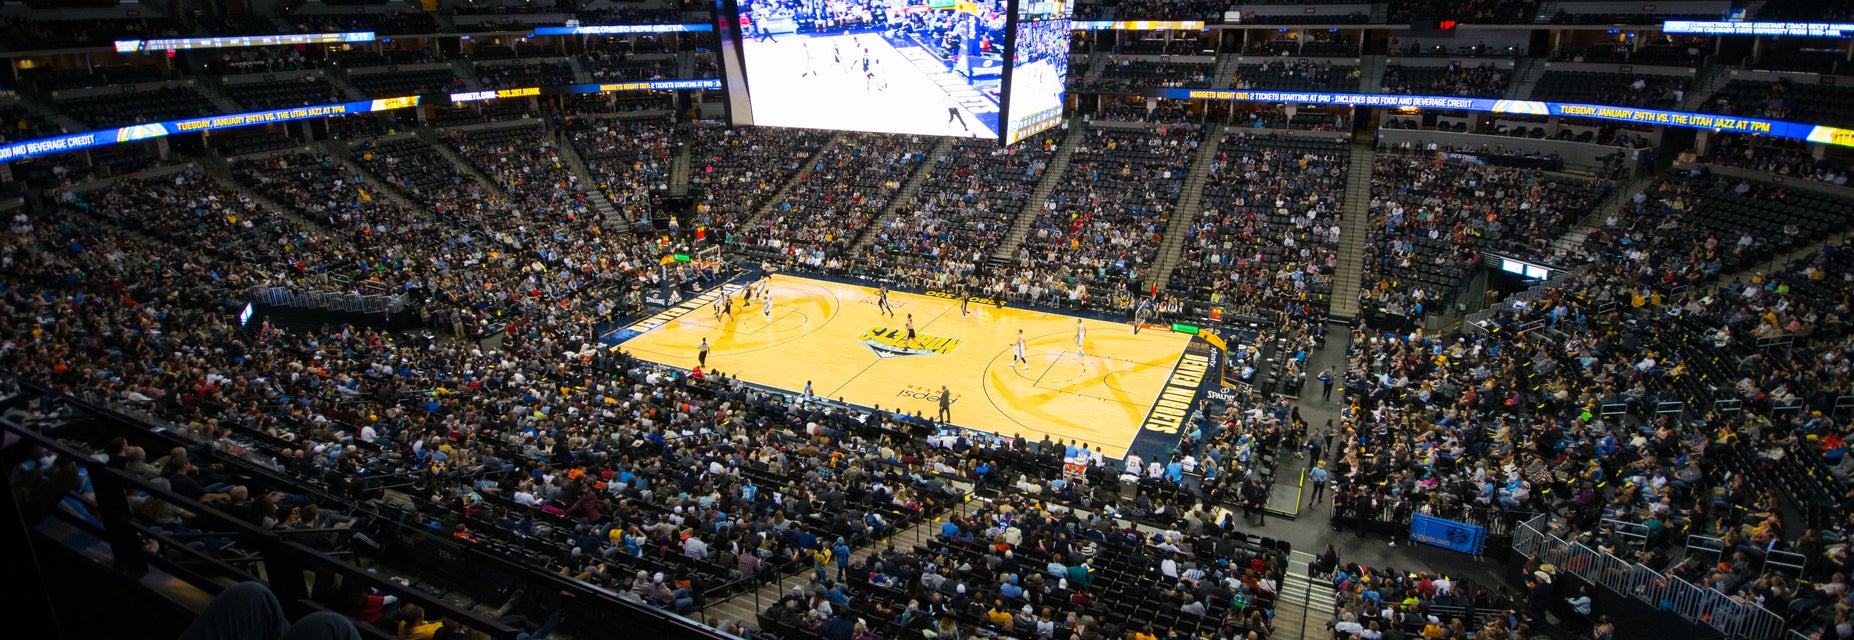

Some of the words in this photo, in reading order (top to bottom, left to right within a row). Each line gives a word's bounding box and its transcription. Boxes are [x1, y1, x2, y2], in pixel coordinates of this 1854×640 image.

[1335, 95, 1365, 103] INCLUDES
[1366, 96, 1379, 104] $30
[1381, 96, 1398, 104] FOOD
[1414, 98, 1446, 106] BEVERAGE
[1447, 99, 1473, 108] CREDIT
[176, 120, 213, 131] TUESDAY,
[214, 117, 245, 128] JANUARY
[246, 115, 264, 125] 24TH
[266, 114, 276, 123] VS.
[278, 112, 290, 121] THE
[291, 109, 306, 120] UTAH
[308, 108, 322, 118] JAZZ
[323, 107, 330, 116] AT
[332, 106, 345, 115] 7PM
[1560, 106, 1598, 116] TUESDAY,
[1598, 107, 1632, 118] JANUARY
[1633, 111, 1655, 121] 24TH
[1657, 113, 1669, 122] VS.
[1672, 115, 1689, 125] THE
[1689, 117, 1712, 126] UTAH
[1714, 118, 1734, 128] JAZZ
[1736, 120, 1748, 129] AT
[1750, 121, 1771, 132] 7PM
[13, 145, 26, 156] AND
[27, 138, 67, 153] BEVERAGE
[67, 135, 94, 148] CREDIT
[1170, 353, 1208, 388] DENVER
[1207, 390, 1235, 400] SPALDIN
[1145, 386, 1196, 434] NUGGETS
